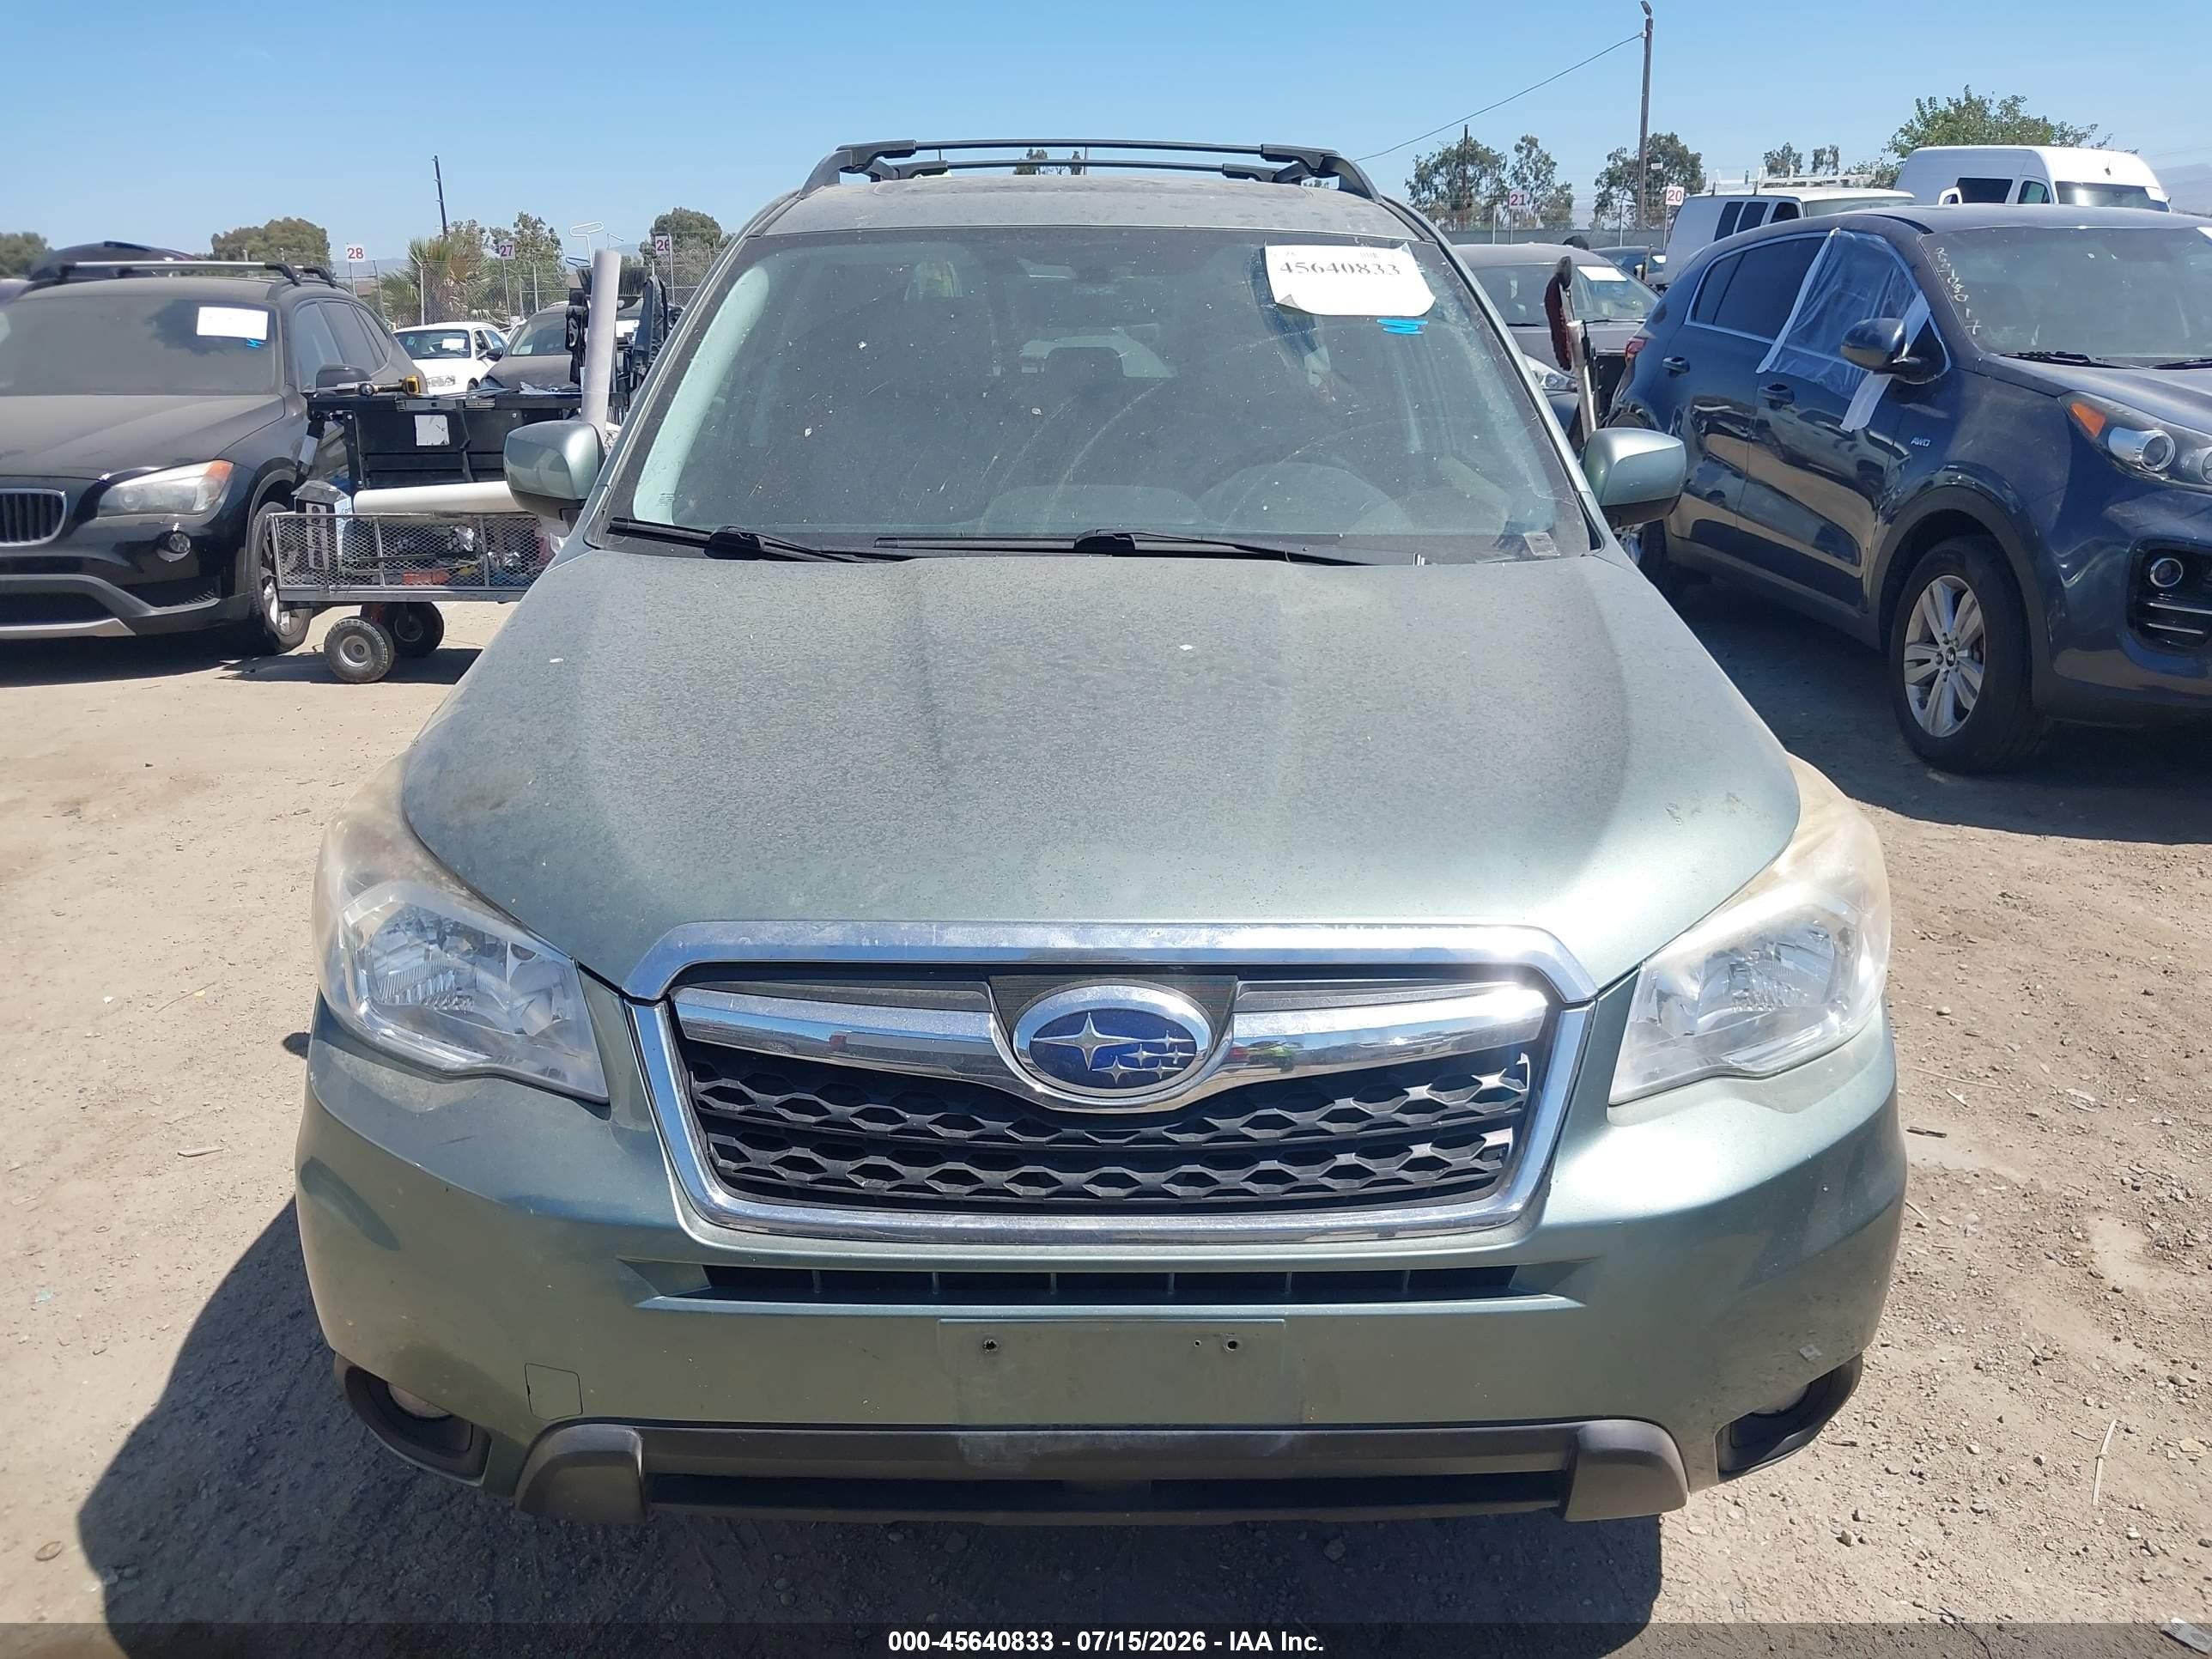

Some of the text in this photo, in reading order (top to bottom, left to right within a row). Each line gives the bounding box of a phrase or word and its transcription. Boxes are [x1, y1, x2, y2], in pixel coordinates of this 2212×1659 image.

[1510, 194, 1526, 206] 21
[1668, 190, 1683, 202] 20
[347, 247, 364, 259] 28
[500, 245, 513, 257] 27
[1279, 261, 1401, 276] 45640833
[1911, 437, 1931, 447] AWD
